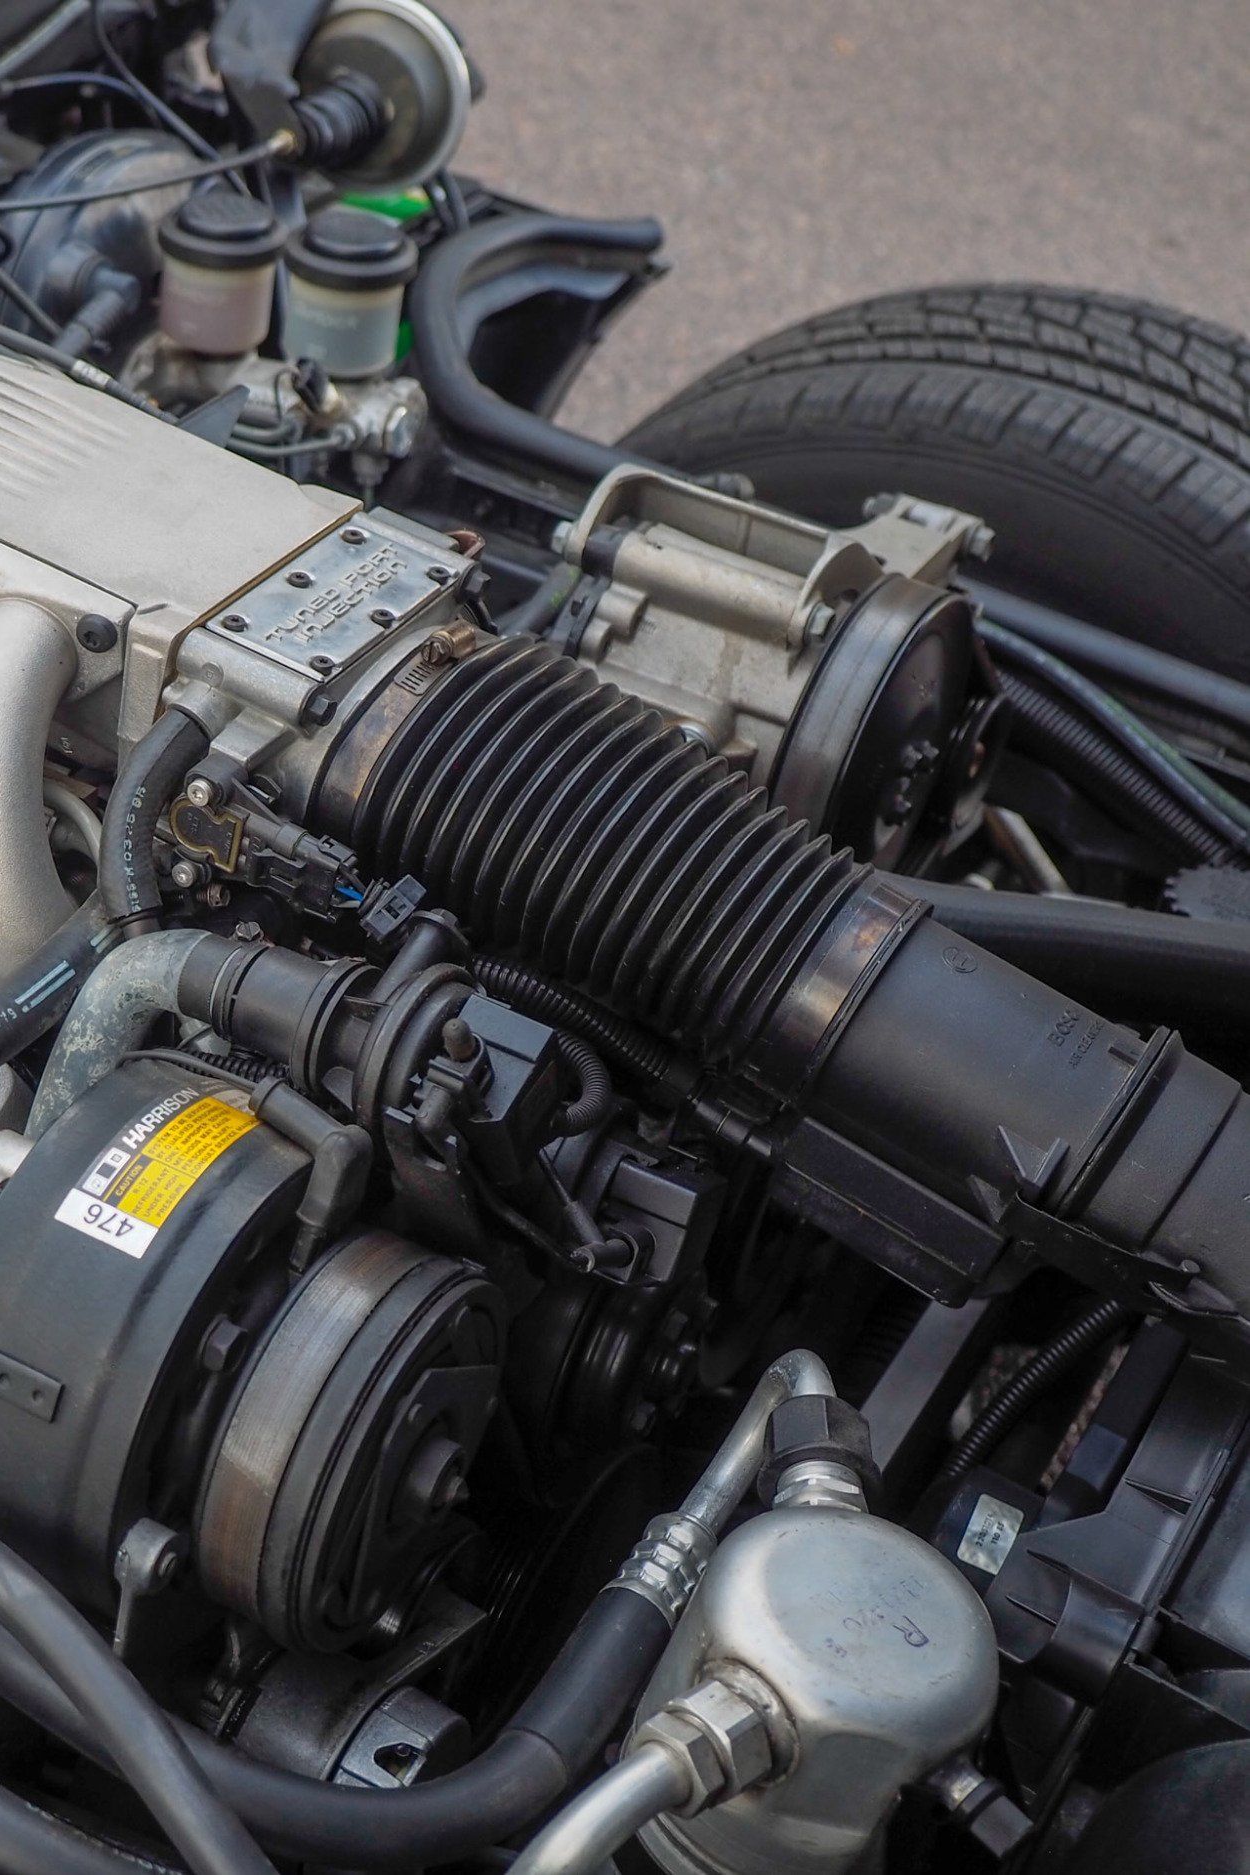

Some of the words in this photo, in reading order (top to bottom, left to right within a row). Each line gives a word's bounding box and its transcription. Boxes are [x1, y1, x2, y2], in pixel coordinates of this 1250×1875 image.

[265, 585, 343, 643] TUNED
[344, 543, 400, 588] PORT
[294, 560, 408, 647] INJECTION
[122, 1086, 200, 1150] HARRISON
[115, 1164, 144, 1197] CAUTION
[83, 1203, 135, 1238] 476
